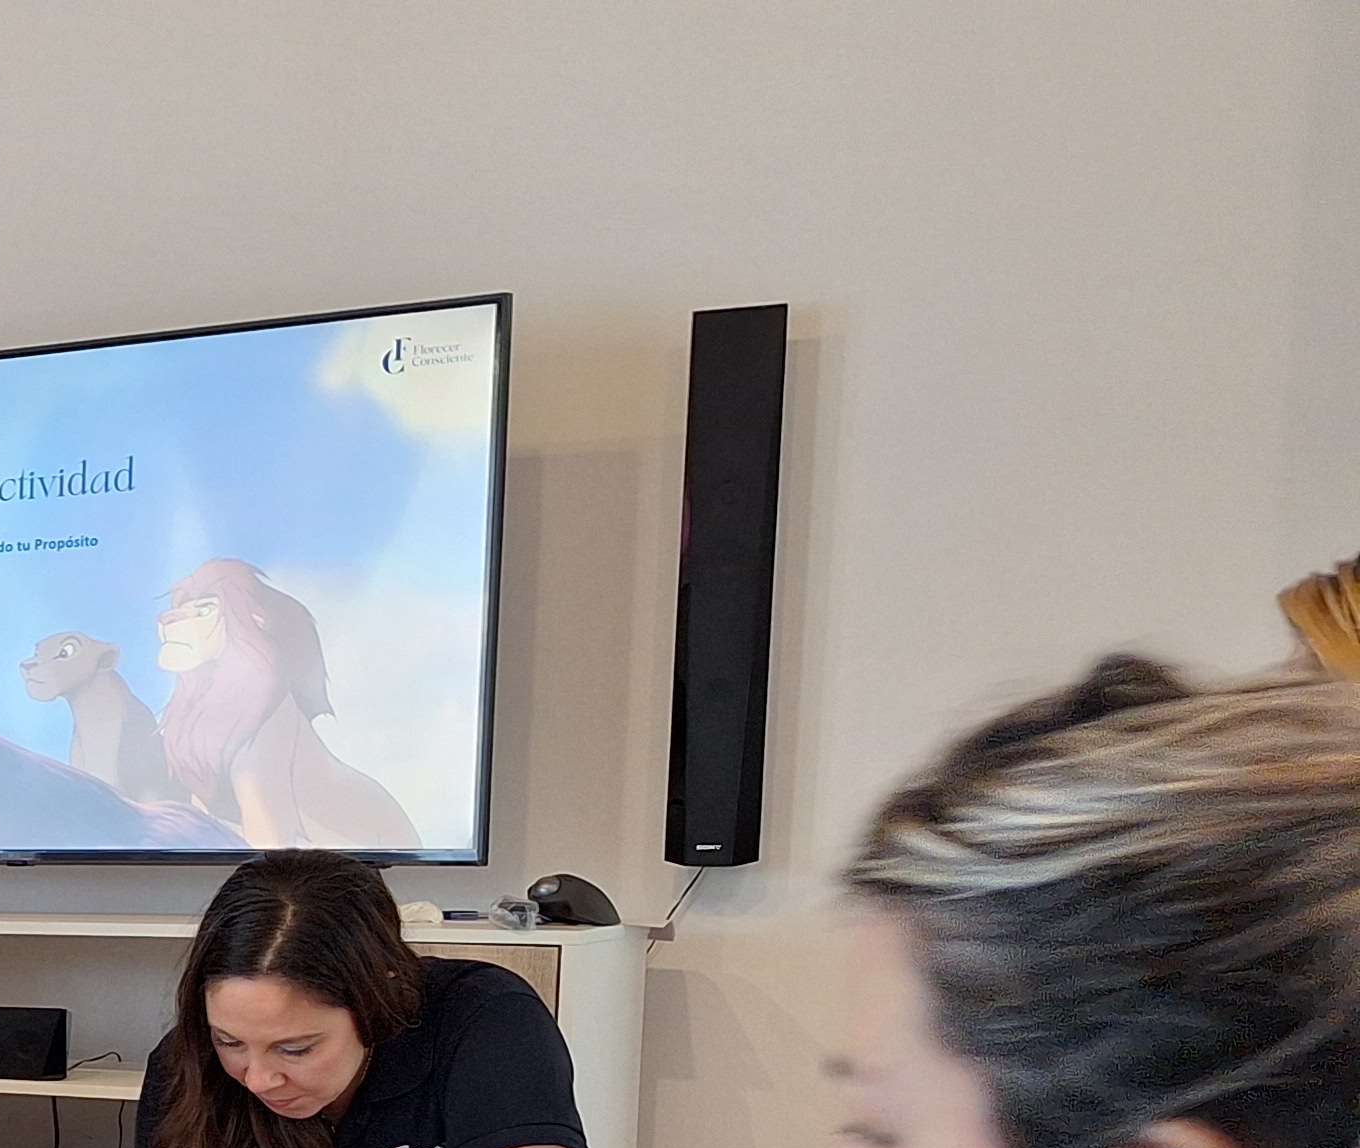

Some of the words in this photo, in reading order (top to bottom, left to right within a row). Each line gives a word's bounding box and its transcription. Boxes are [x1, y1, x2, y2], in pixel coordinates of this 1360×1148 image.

[413, 343, 461, 355] Florecer
[411, 352, 474, 367] Consciente
[16, 541, 30, 552] tu
[34, 535, 98, 552] Propósito
